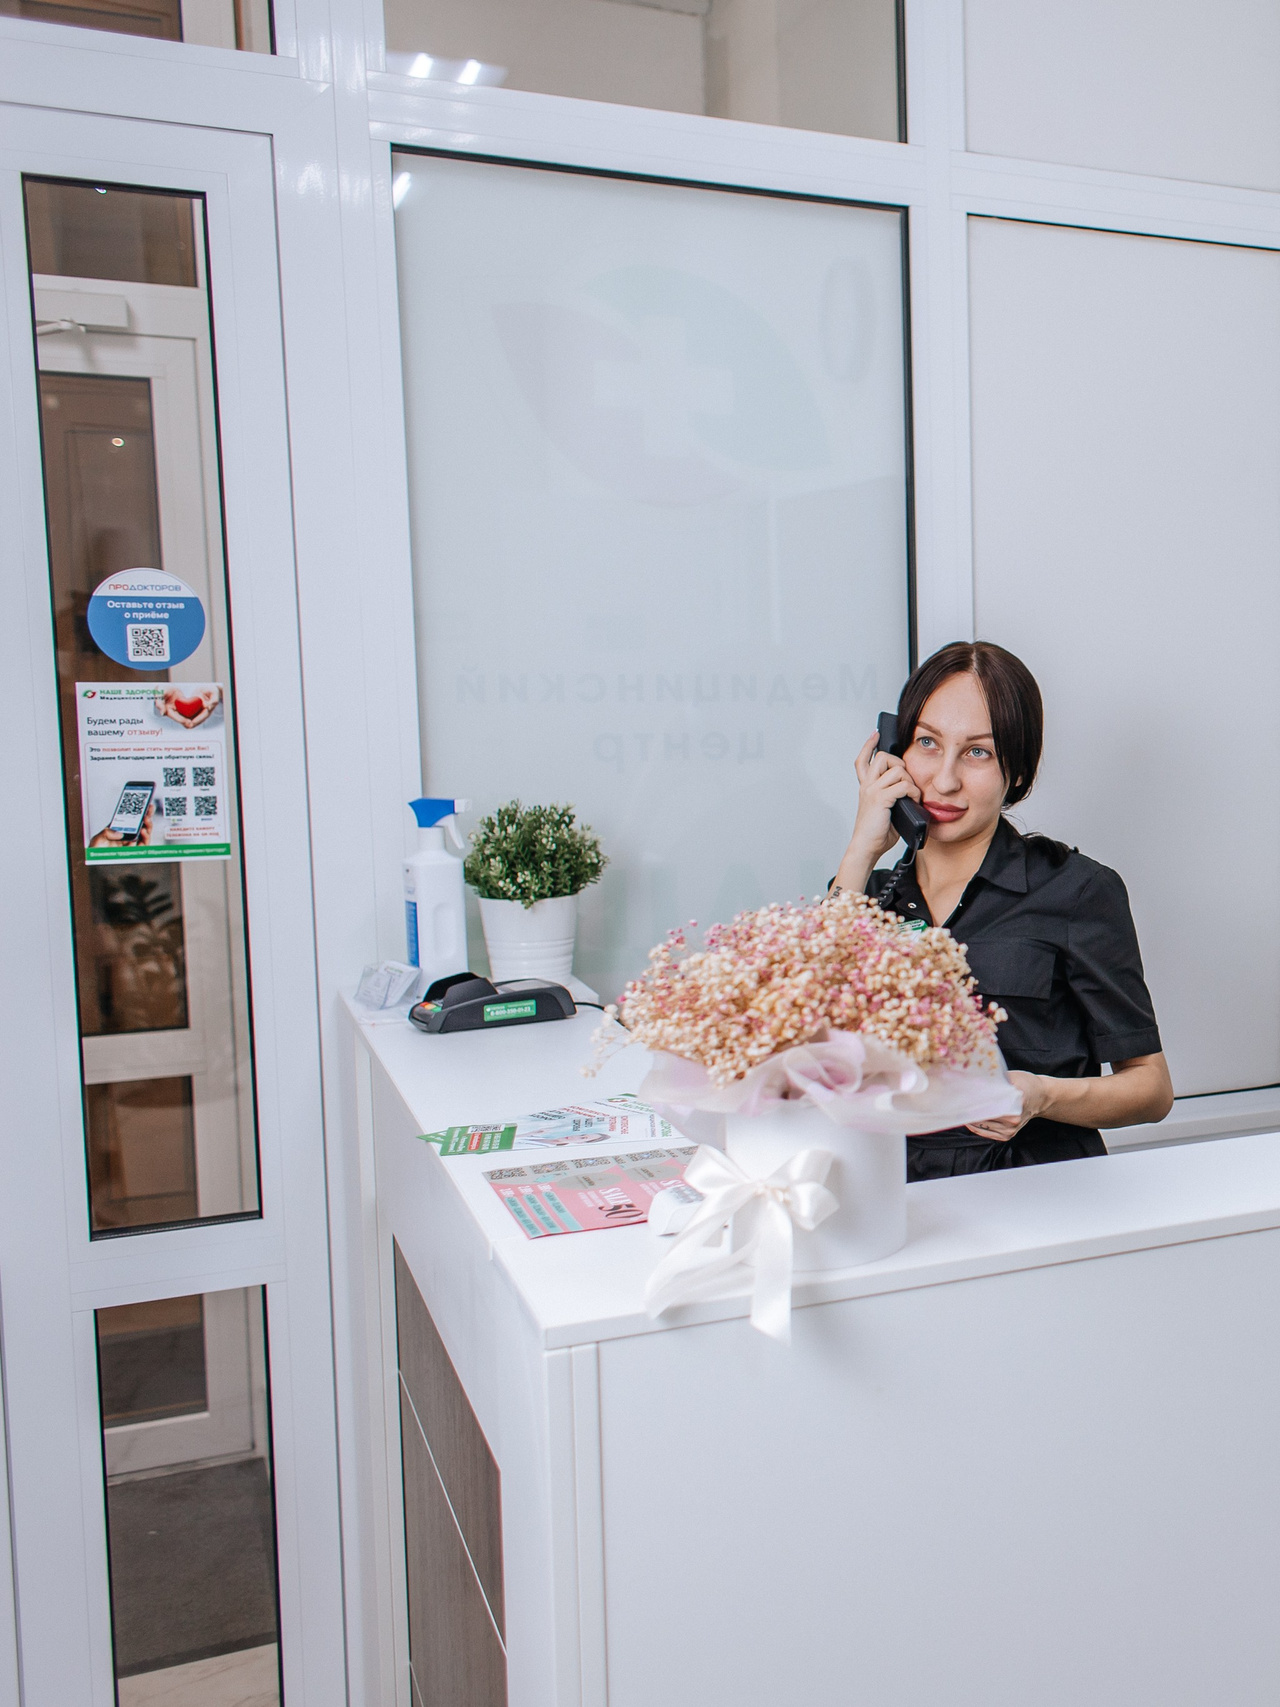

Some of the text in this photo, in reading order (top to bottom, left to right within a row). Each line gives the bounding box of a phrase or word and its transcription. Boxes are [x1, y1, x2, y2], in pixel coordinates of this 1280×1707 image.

[108, 583, 181, 591] ПРОДОКТОРОВ
[107, 600, 153, 609] Оставьте
[132, 611, 169, 620] приёме
[87, 717, 144, 726] Будем рады
[87, 728, 163, 737] вашему отзыву!
